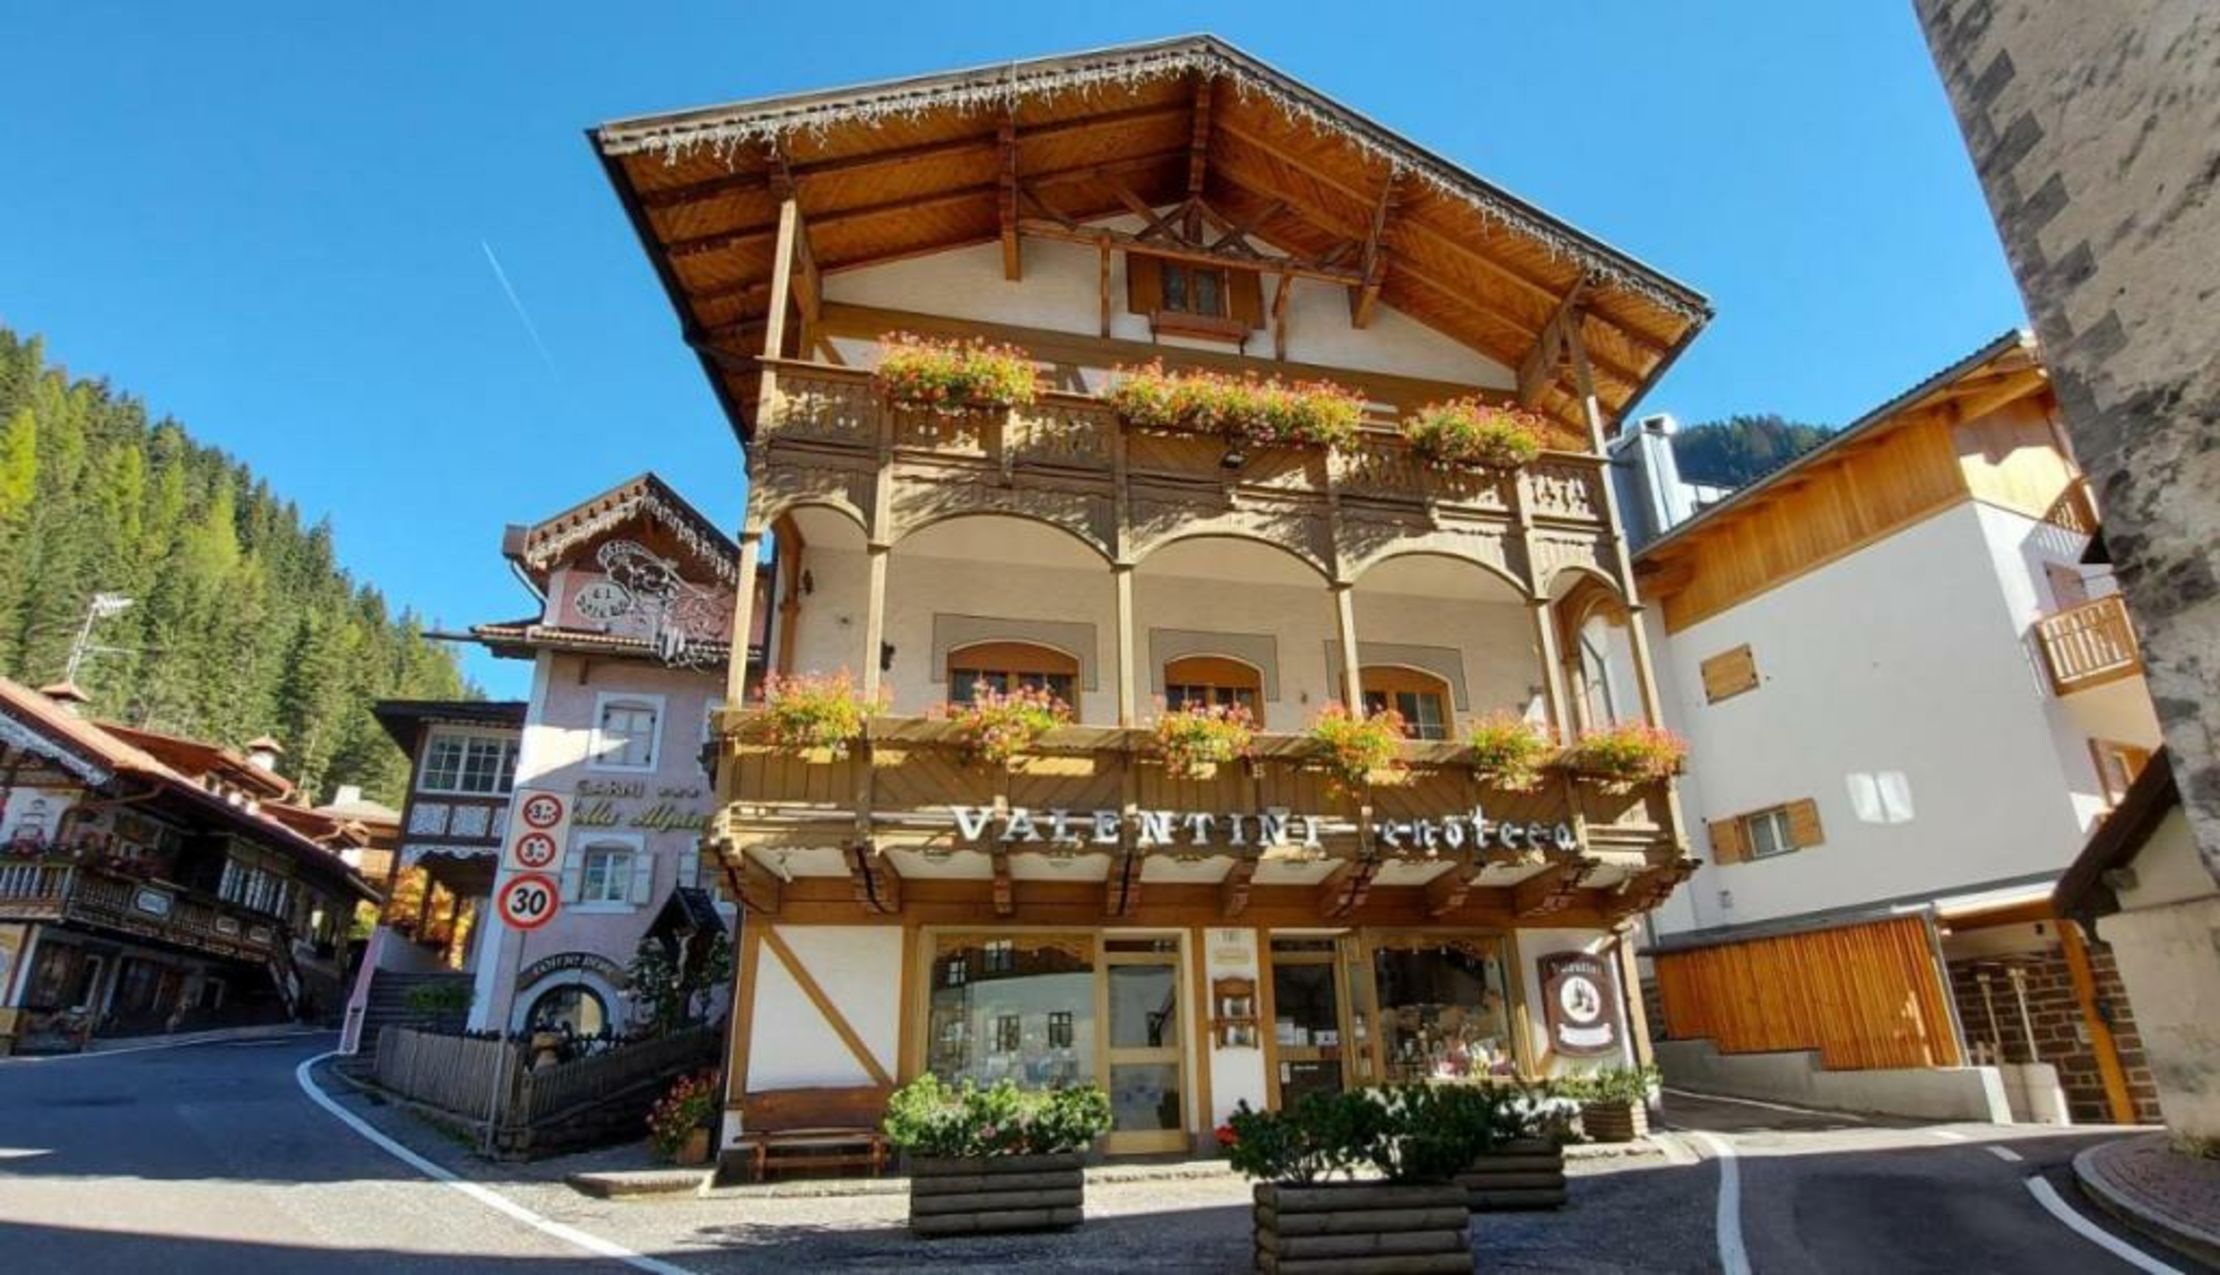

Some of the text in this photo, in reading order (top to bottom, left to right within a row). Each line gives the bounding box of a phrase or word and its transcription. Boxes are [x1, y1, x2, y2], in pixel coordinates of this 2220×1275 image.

[950, 804, 1577, 850] VALENTINI enoteca
[511, 887, 547, 916] 30
